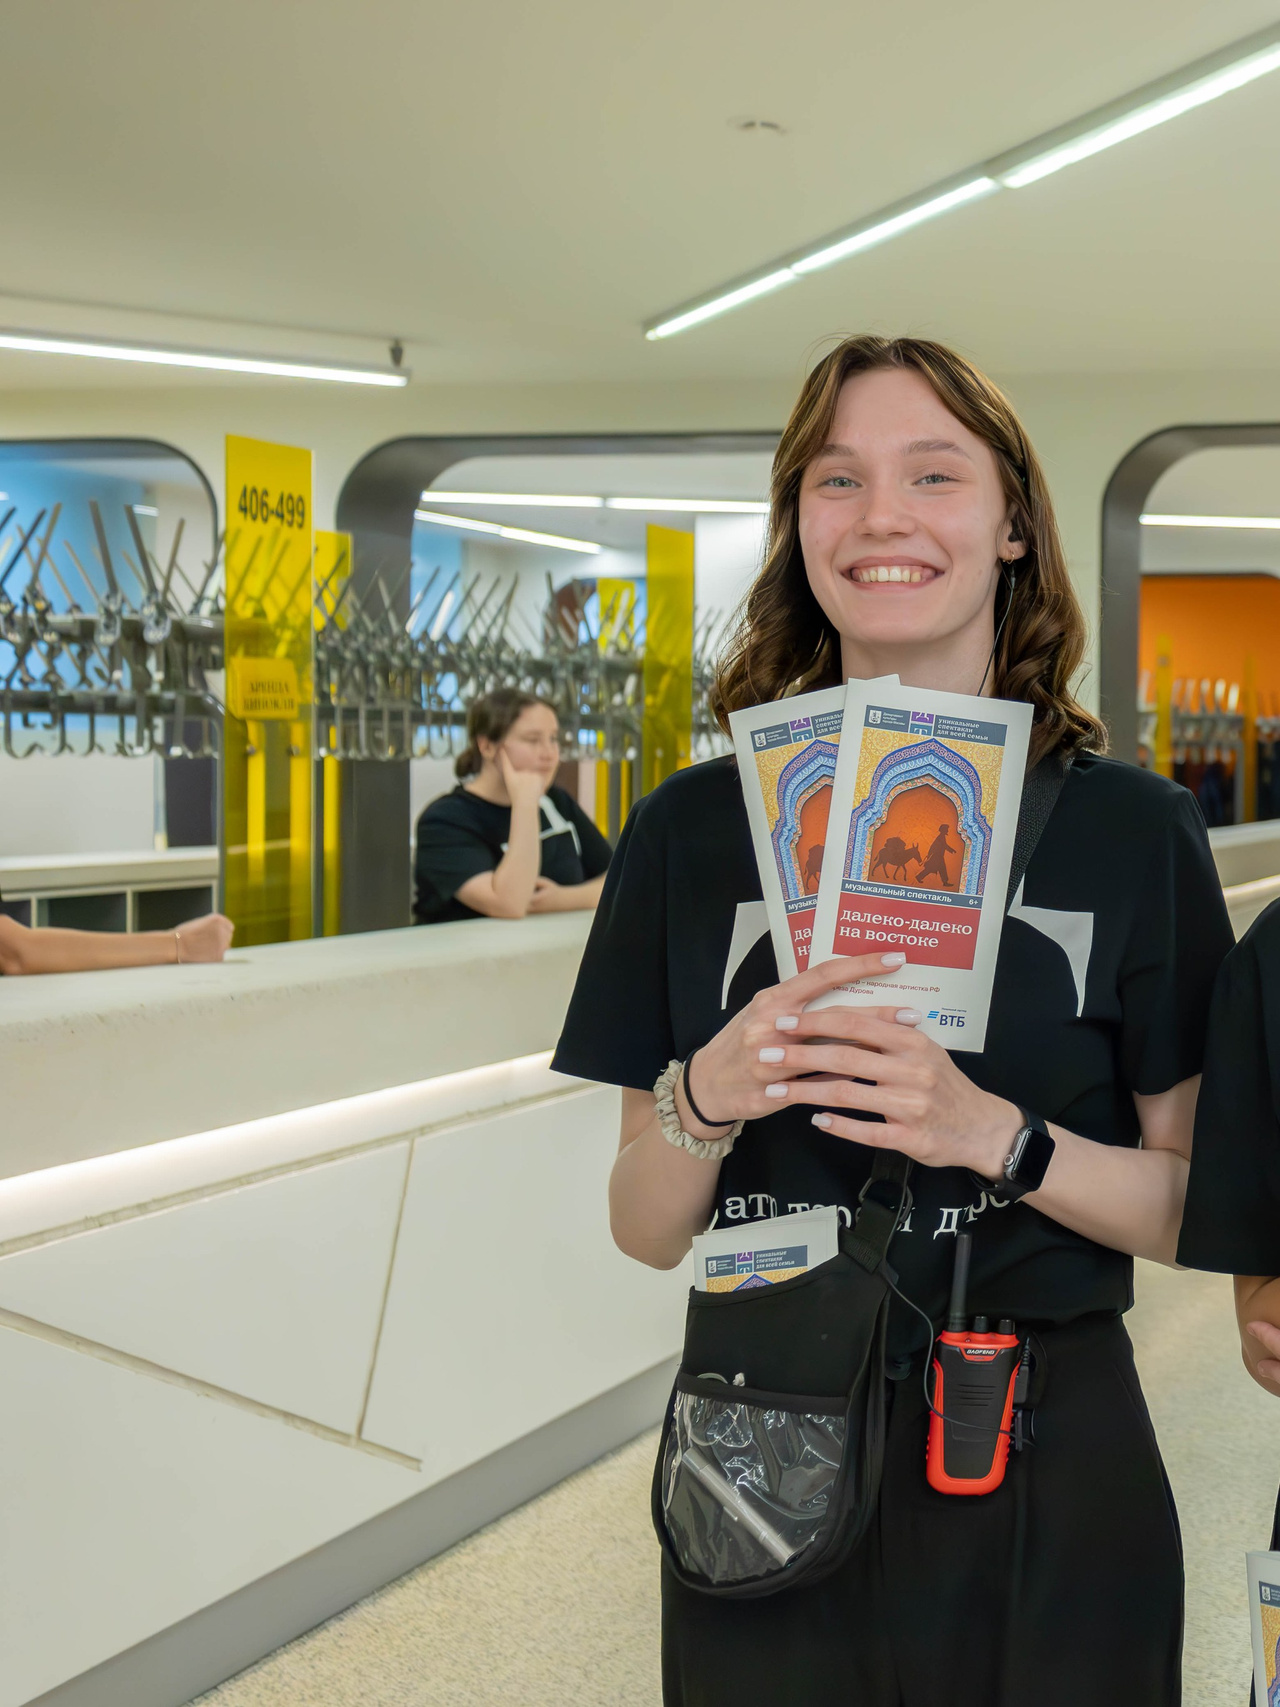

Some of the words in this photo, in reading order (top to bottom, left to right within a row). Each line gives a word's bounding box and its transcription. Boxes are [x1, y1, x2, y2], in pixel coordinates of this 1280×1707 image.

[238, 484, 305, 529] 406-499
[937, 724, 973, 733] спектакли
[938, 718, 980, 728] уникальные
[844, 882, 906, 896] музыкальный
[907, 891, 952, 903] спектакль
[840, 909, 973, 935] далеко-далеко
[839, 926, 861, 939] на
[864, 929, 939, 948] востоке
[939, 1014, 965, 1028] ВТБ
